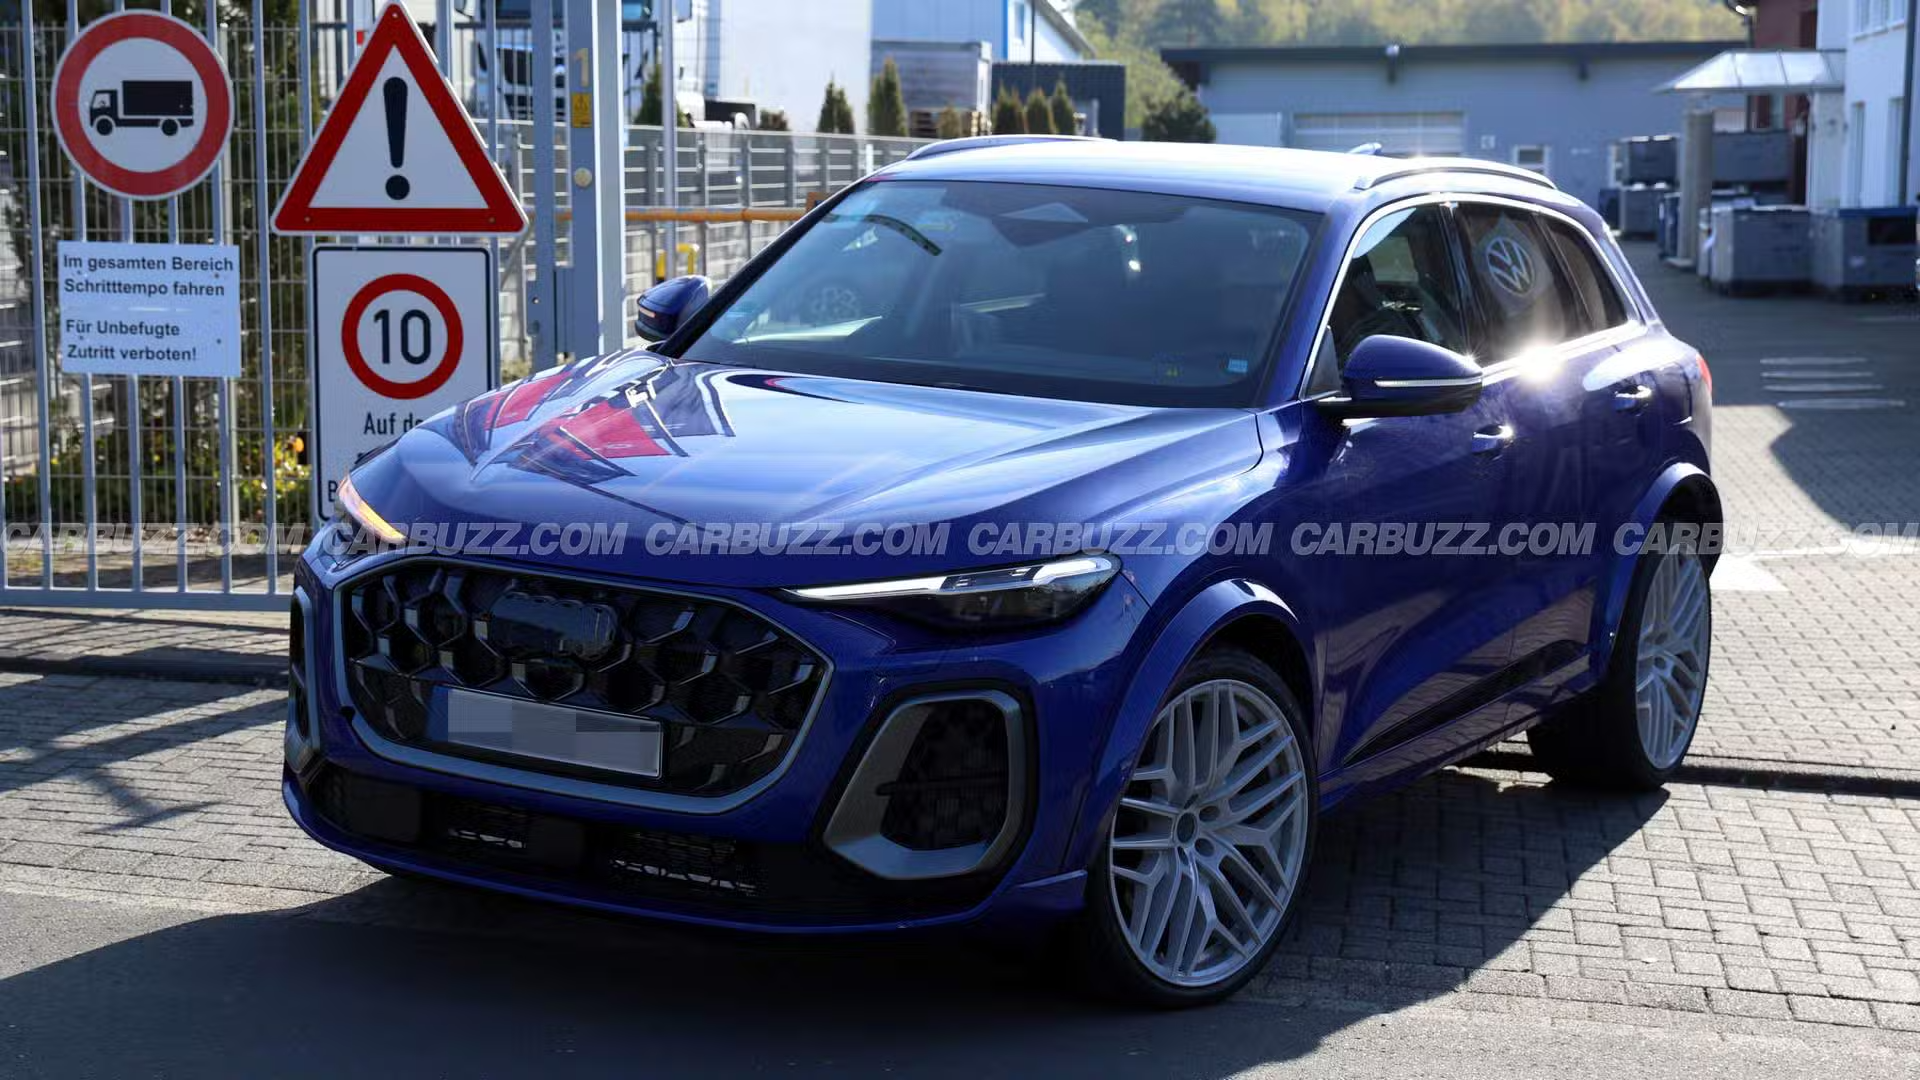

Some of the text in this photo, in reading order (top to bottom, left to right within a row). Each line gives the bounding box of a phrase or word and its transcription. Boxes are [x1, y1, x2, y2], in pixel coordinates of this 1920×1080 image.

[63, 255, 234, 272] Im gesamten Bereich
[64, 278, 225, 297] Schritttempo fahren
[66, 319, 180, 339] Für Unbefugte
[373, 309, 431, 365] 10
[67, 344, 197, 361] Zutritt verboten!
[363, 412, 396, 435] Auf
